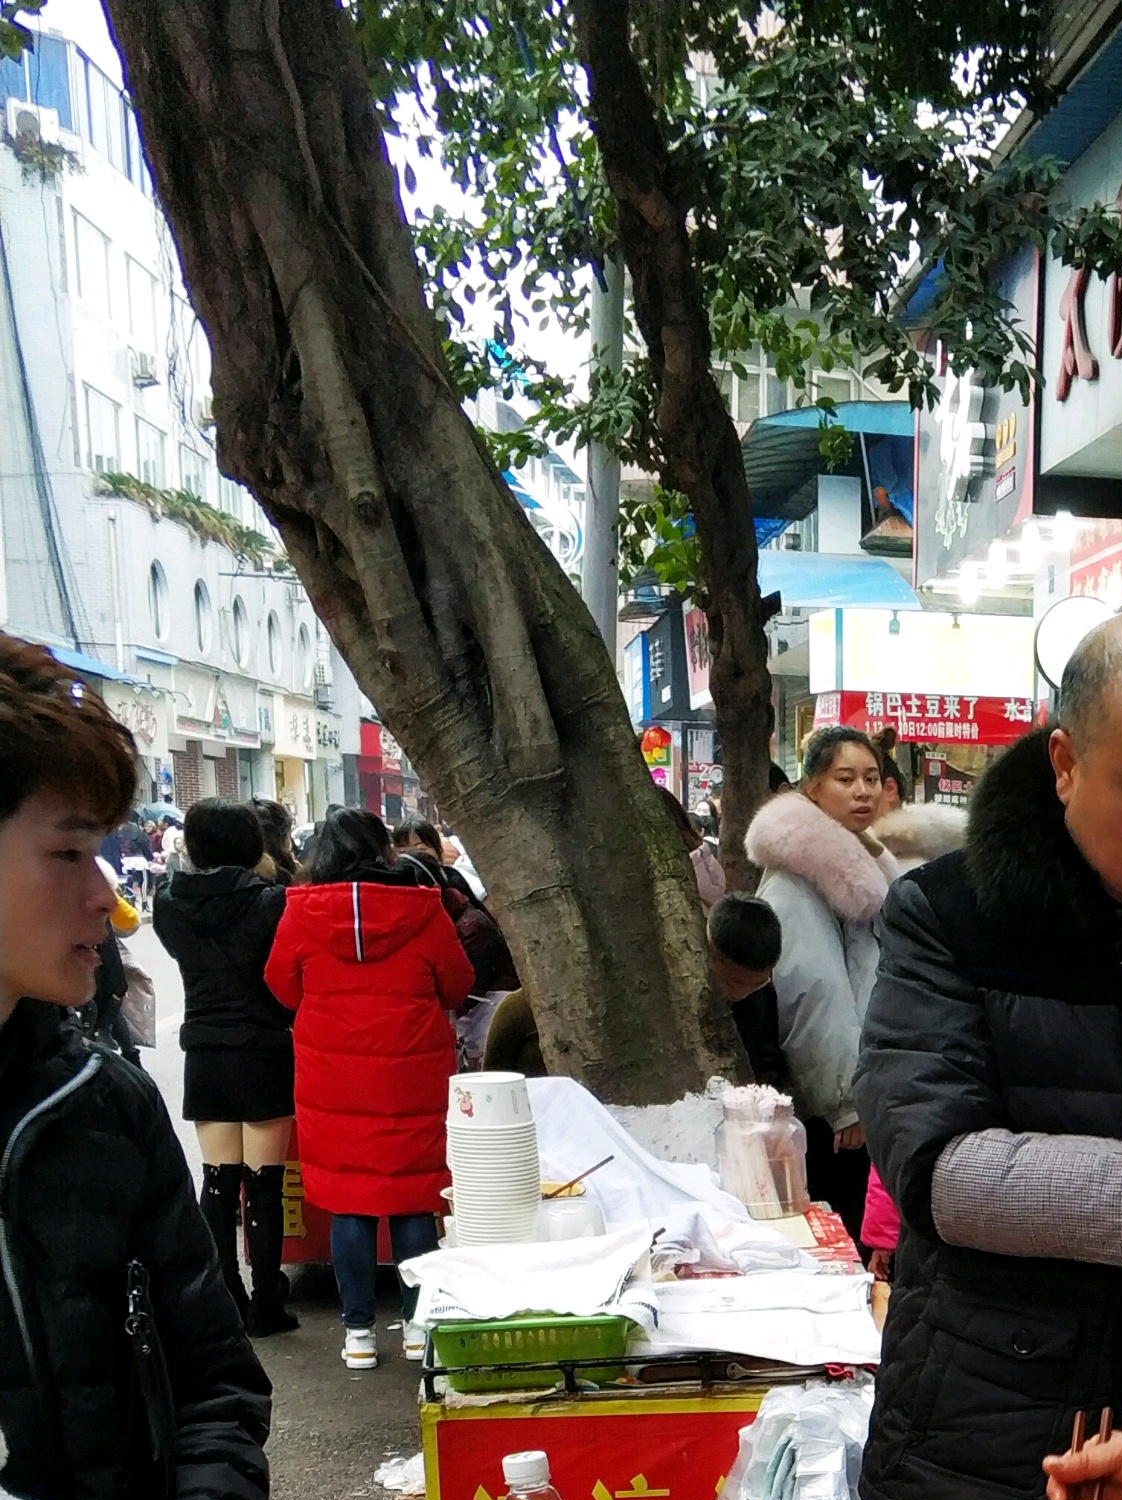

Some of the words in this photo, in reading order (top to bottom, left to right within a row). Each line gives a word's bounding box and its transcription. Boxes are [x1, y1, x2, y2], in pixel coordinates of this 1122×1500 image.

[865, 691, 979, 721] 锅巴土豆来了
